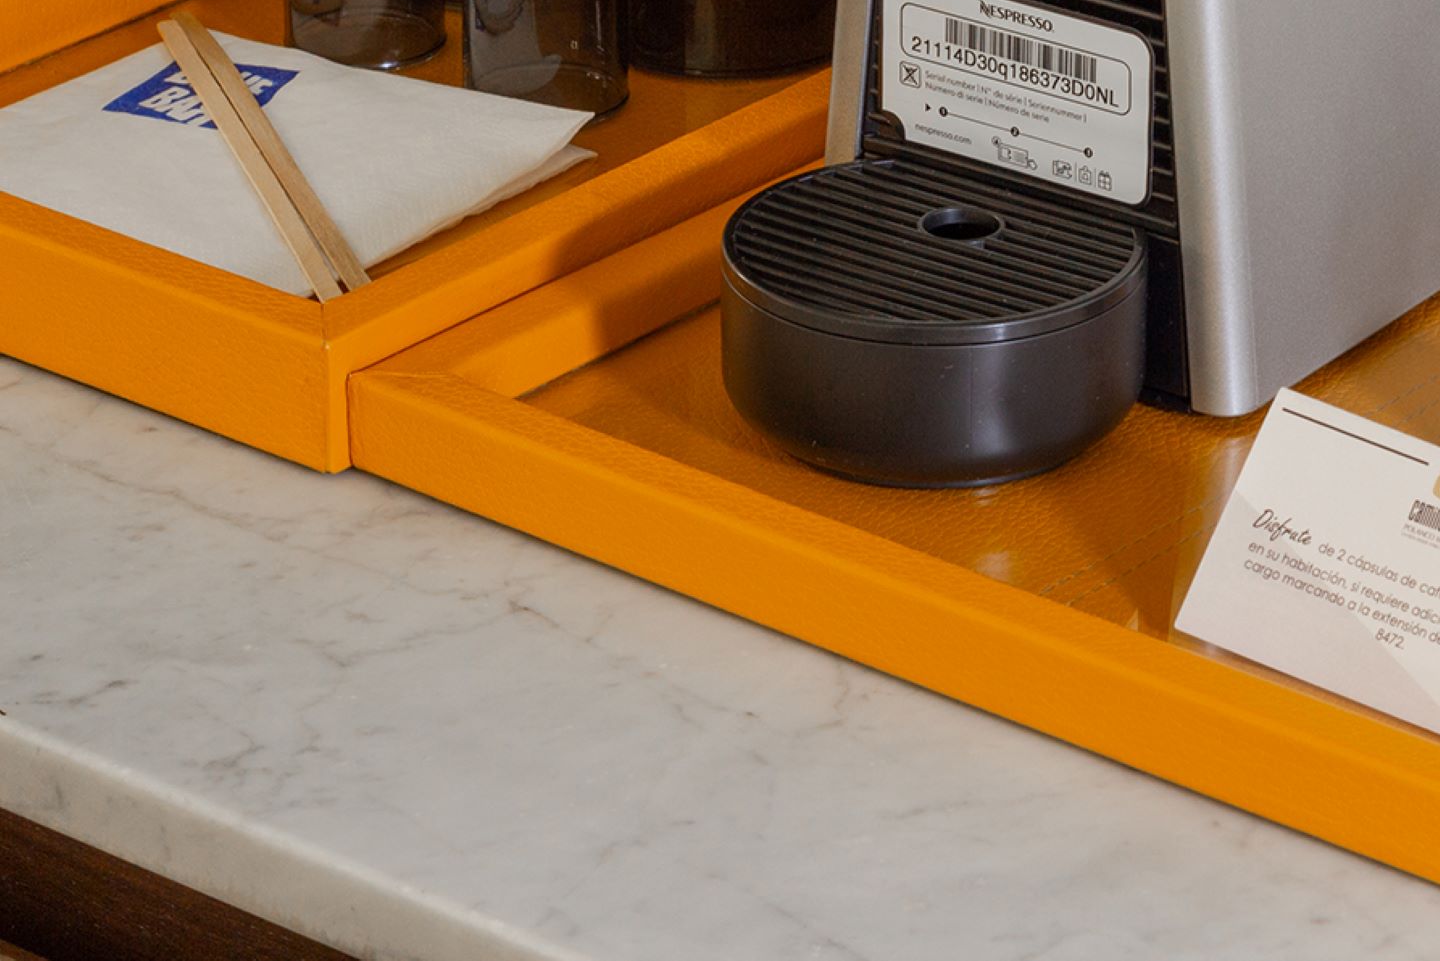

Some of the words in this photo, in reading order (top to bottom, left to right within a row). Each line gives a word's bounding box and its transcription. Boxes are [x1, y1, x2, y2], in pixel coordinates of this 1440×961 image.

[1248, 542, 1265, 556] en
[1266, 548, 1280, 562] su
[1361, 585, 1410, 613] requiere
[1252, 508, 1312, 545] Disfrute
[1318, 542, 1335, 557] de
[1336, 548, 1347, 562] 2
[1347, 553, 1399, 583] cápsulas
[1400, 575, 1417, 589] de
[1243, 558, 1281, 581] cargo
[1281, 572, 1345, 607] marcando
[1347, 599, 1357, 611] a
[1358, 601, 1371, 617] la
[1372, 609, 1428, 639] extensión
